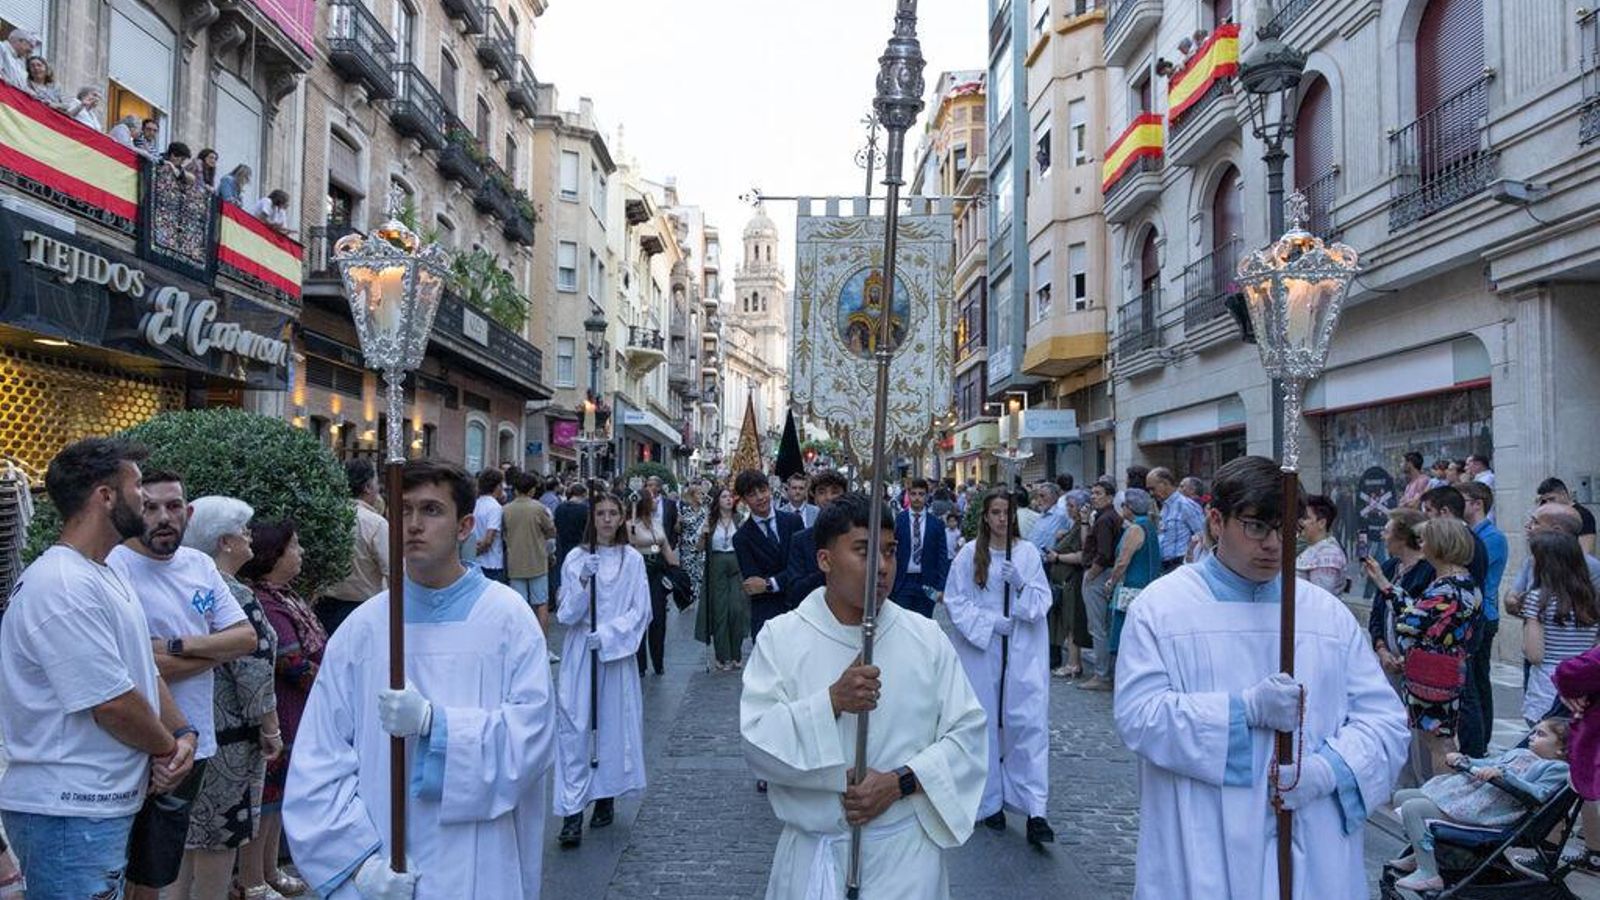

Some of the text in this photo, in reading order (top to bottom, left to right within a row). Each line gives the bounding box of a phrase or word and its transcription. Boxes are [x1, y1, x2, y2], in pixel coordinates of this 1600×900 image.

[23, 230, 145, 298] TEJIDOS
[144, 286, 288, 367] El Carmen
[72, 792, 96, 801] THINGS
